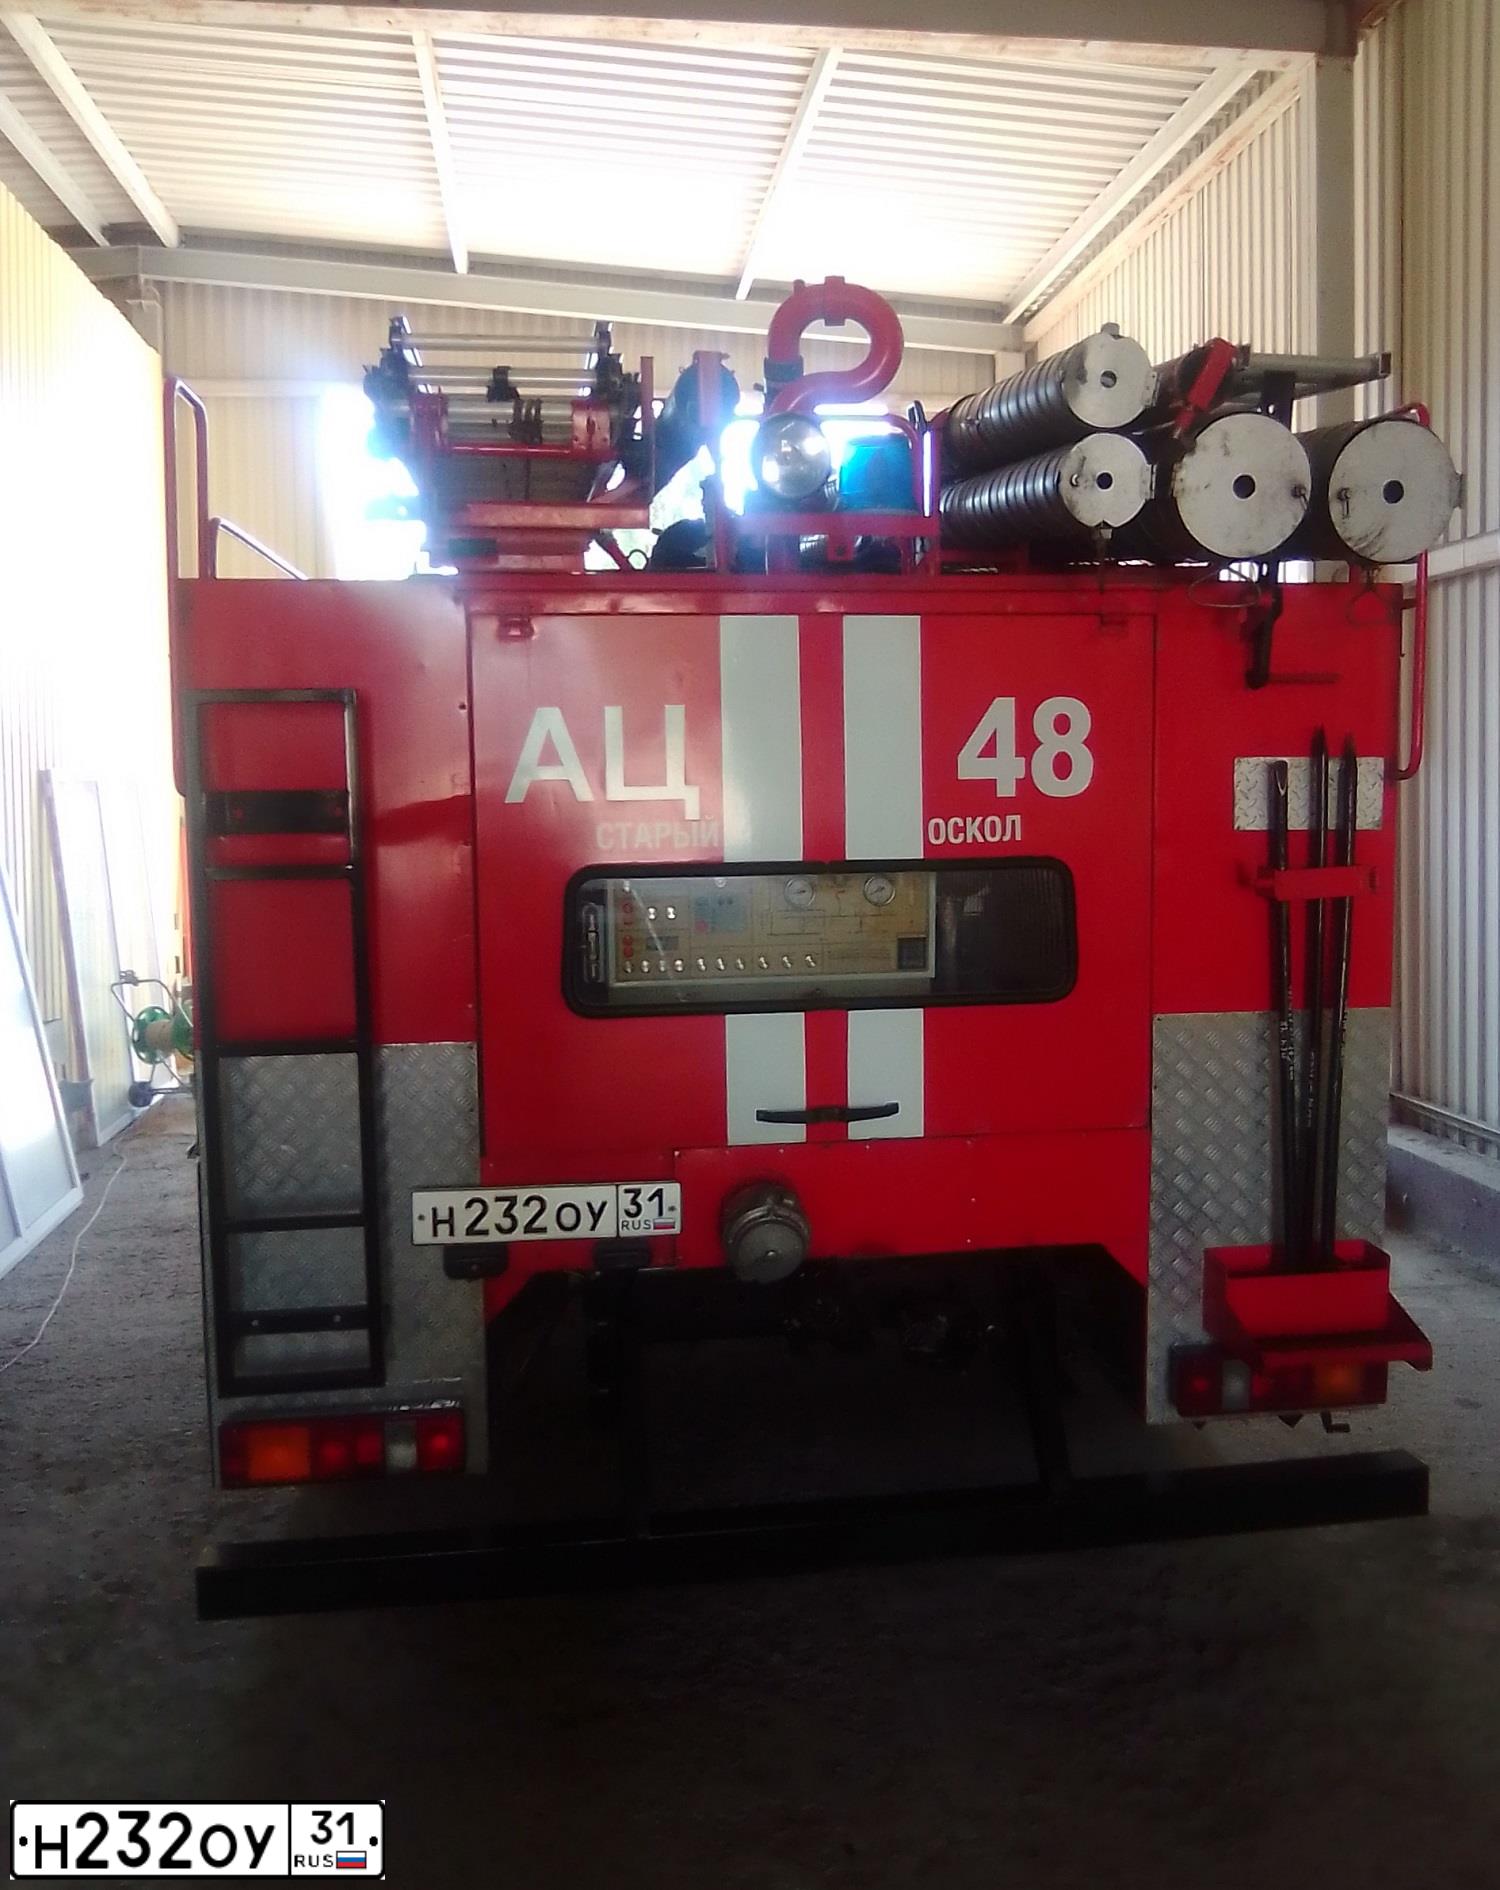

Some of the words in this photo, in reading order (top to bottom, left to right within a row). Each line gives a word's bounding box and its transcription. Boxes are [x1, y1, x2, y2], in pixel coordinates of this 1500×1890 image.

[504, 704, 700, 820] АЦ
[956, 696, 1095, 798] 48
[595, 815, 720, 850] СТАРЫЙ
[927, 814, 1022, 845] ОСКОЛ
[623, 1187, 664, 1218] 31
[621, 1219, 651, 1231] RUS
